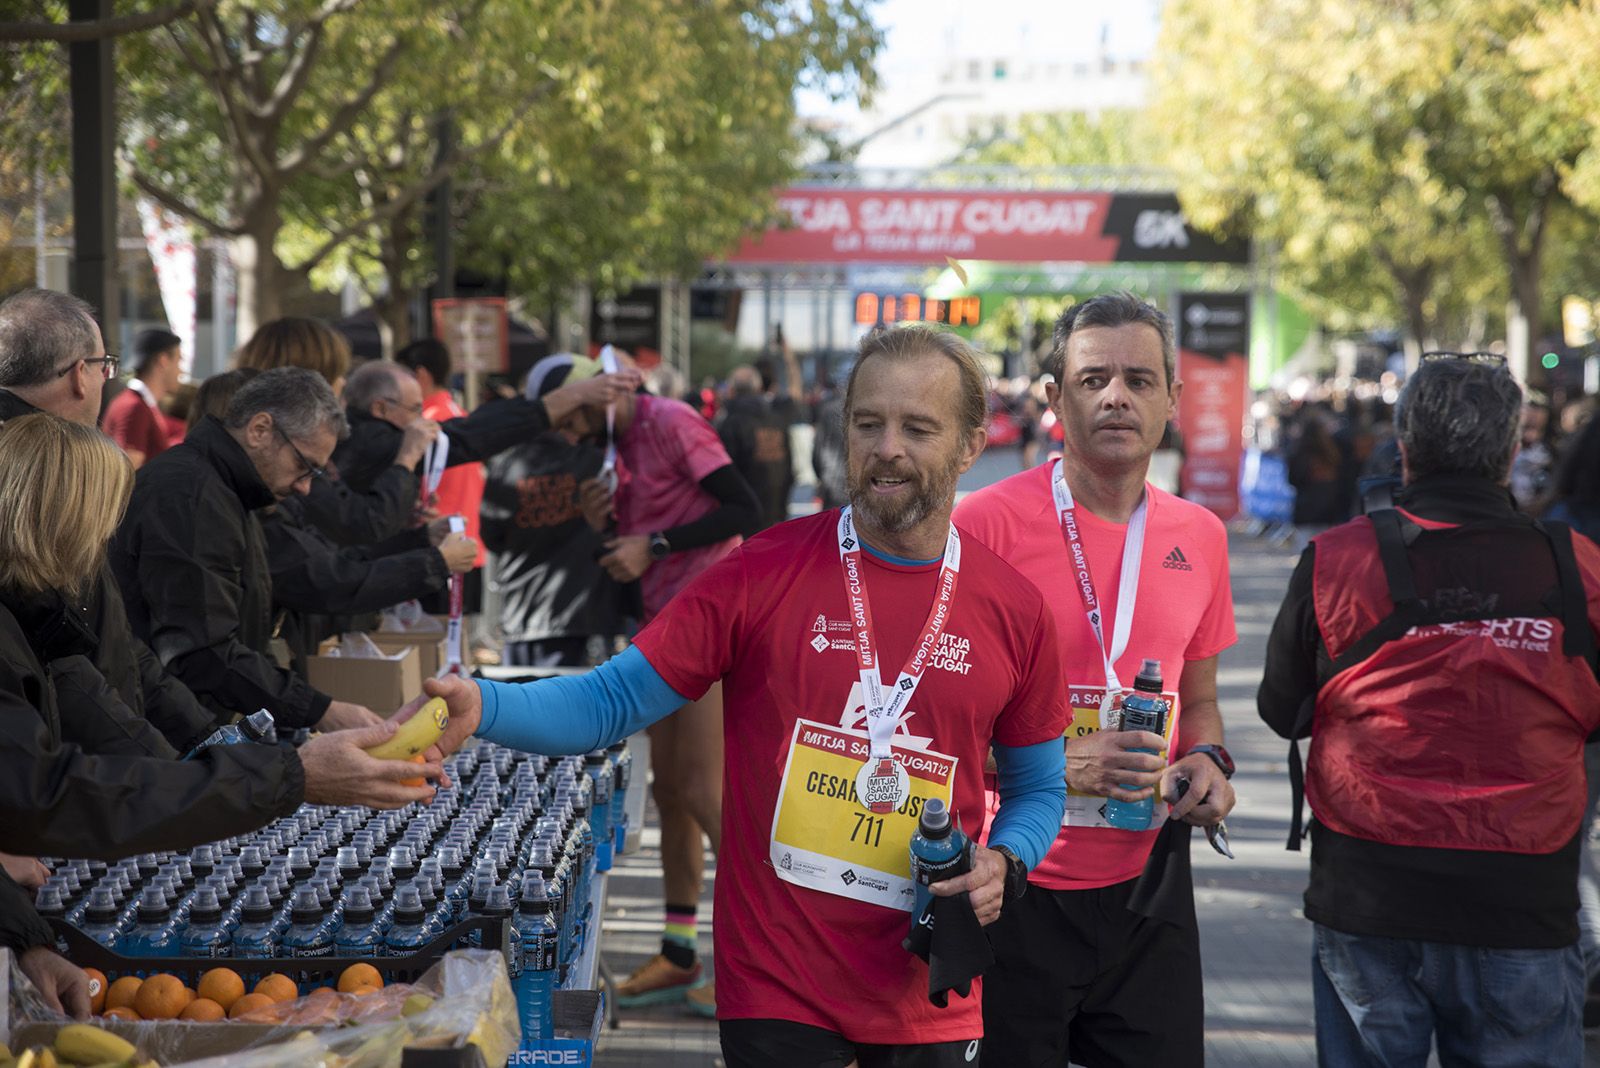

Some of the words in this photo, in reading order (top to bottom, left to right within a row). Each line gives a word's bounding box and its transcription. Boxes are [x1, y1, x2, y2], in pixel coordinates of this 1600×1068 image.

[780, 198, 850, 232] TJA
[859, 198, 959, 231] SANT
[962, 199, 1096, 235] CUGAT
[1064, 512, 1079, 541] MITJA
[1071, 543, 1086, 570] SANT
[1162, 561, 1193, 572] adidas
[846, 557, 861, 594] CUGAT
[940, 570, 954, 601] MITJA
[1078, 571, 1096, 606] CUGAT
[852, 597, 867, 627] SANT
[930, 604, 947, 634] SANT
[1489, 617, 1554, 640] RTS
[831, 643, 857, 652] SantCu
[858, 631, 873, 665] MITJA
[911, 634, 934, 673] CUGAT
[803, 731, 846, 752] MITJA
[850, 742, 871, 757] SA
[869, 777, 896, 786] MITJA
[870, 785, 896, 794] SANT
[867, 792, 899, 802] CUGAT
[850, 812, 884, 848] 711
[857, 880, 889, 892] SantCugat
